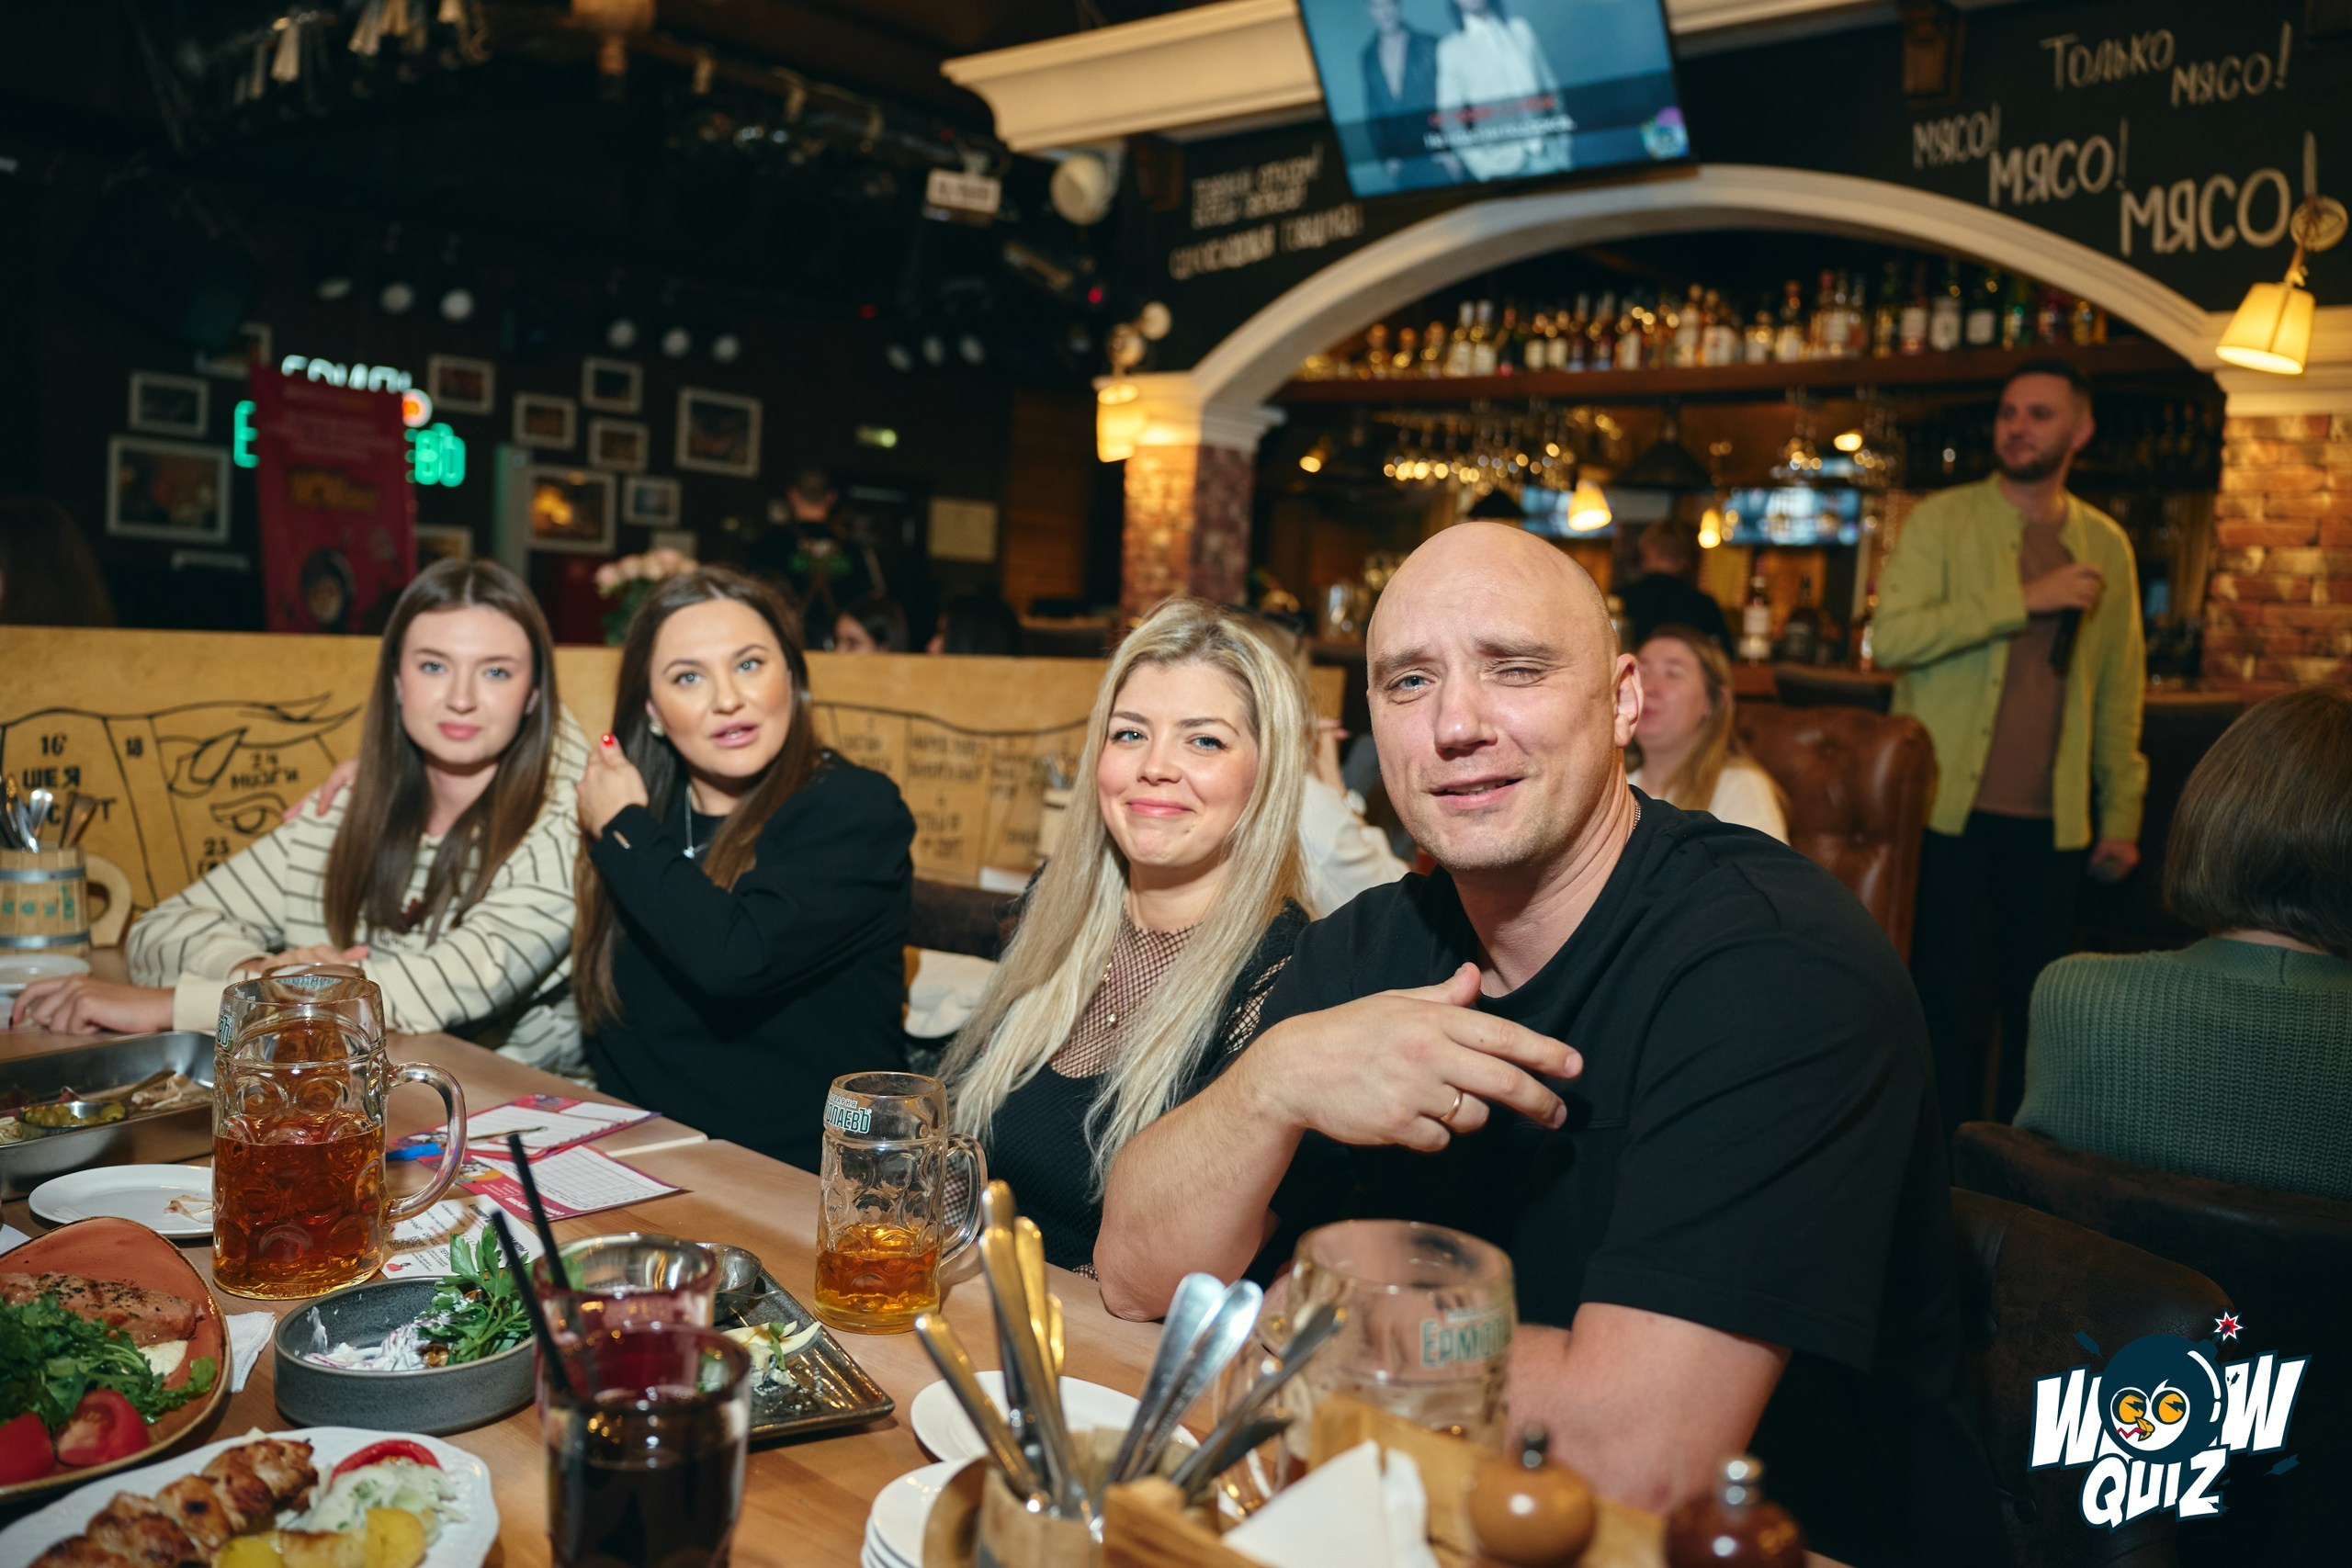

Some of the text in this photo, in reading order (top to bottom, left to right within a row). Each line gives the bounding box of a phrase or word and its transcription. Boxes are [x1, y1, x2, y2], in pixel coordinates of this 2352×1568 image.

[2170, 20, 2292, 108] МЯСО!
[1912, 101, 2001, 170] МЯСО!
[1988, 116, 2129, 208] МЯСО!
[40, 732, 67, 756] 16
[23, 765, 81, 790] ШЕЯ
[826, 1102, 871, 1134] ОЛАЕВЪ
